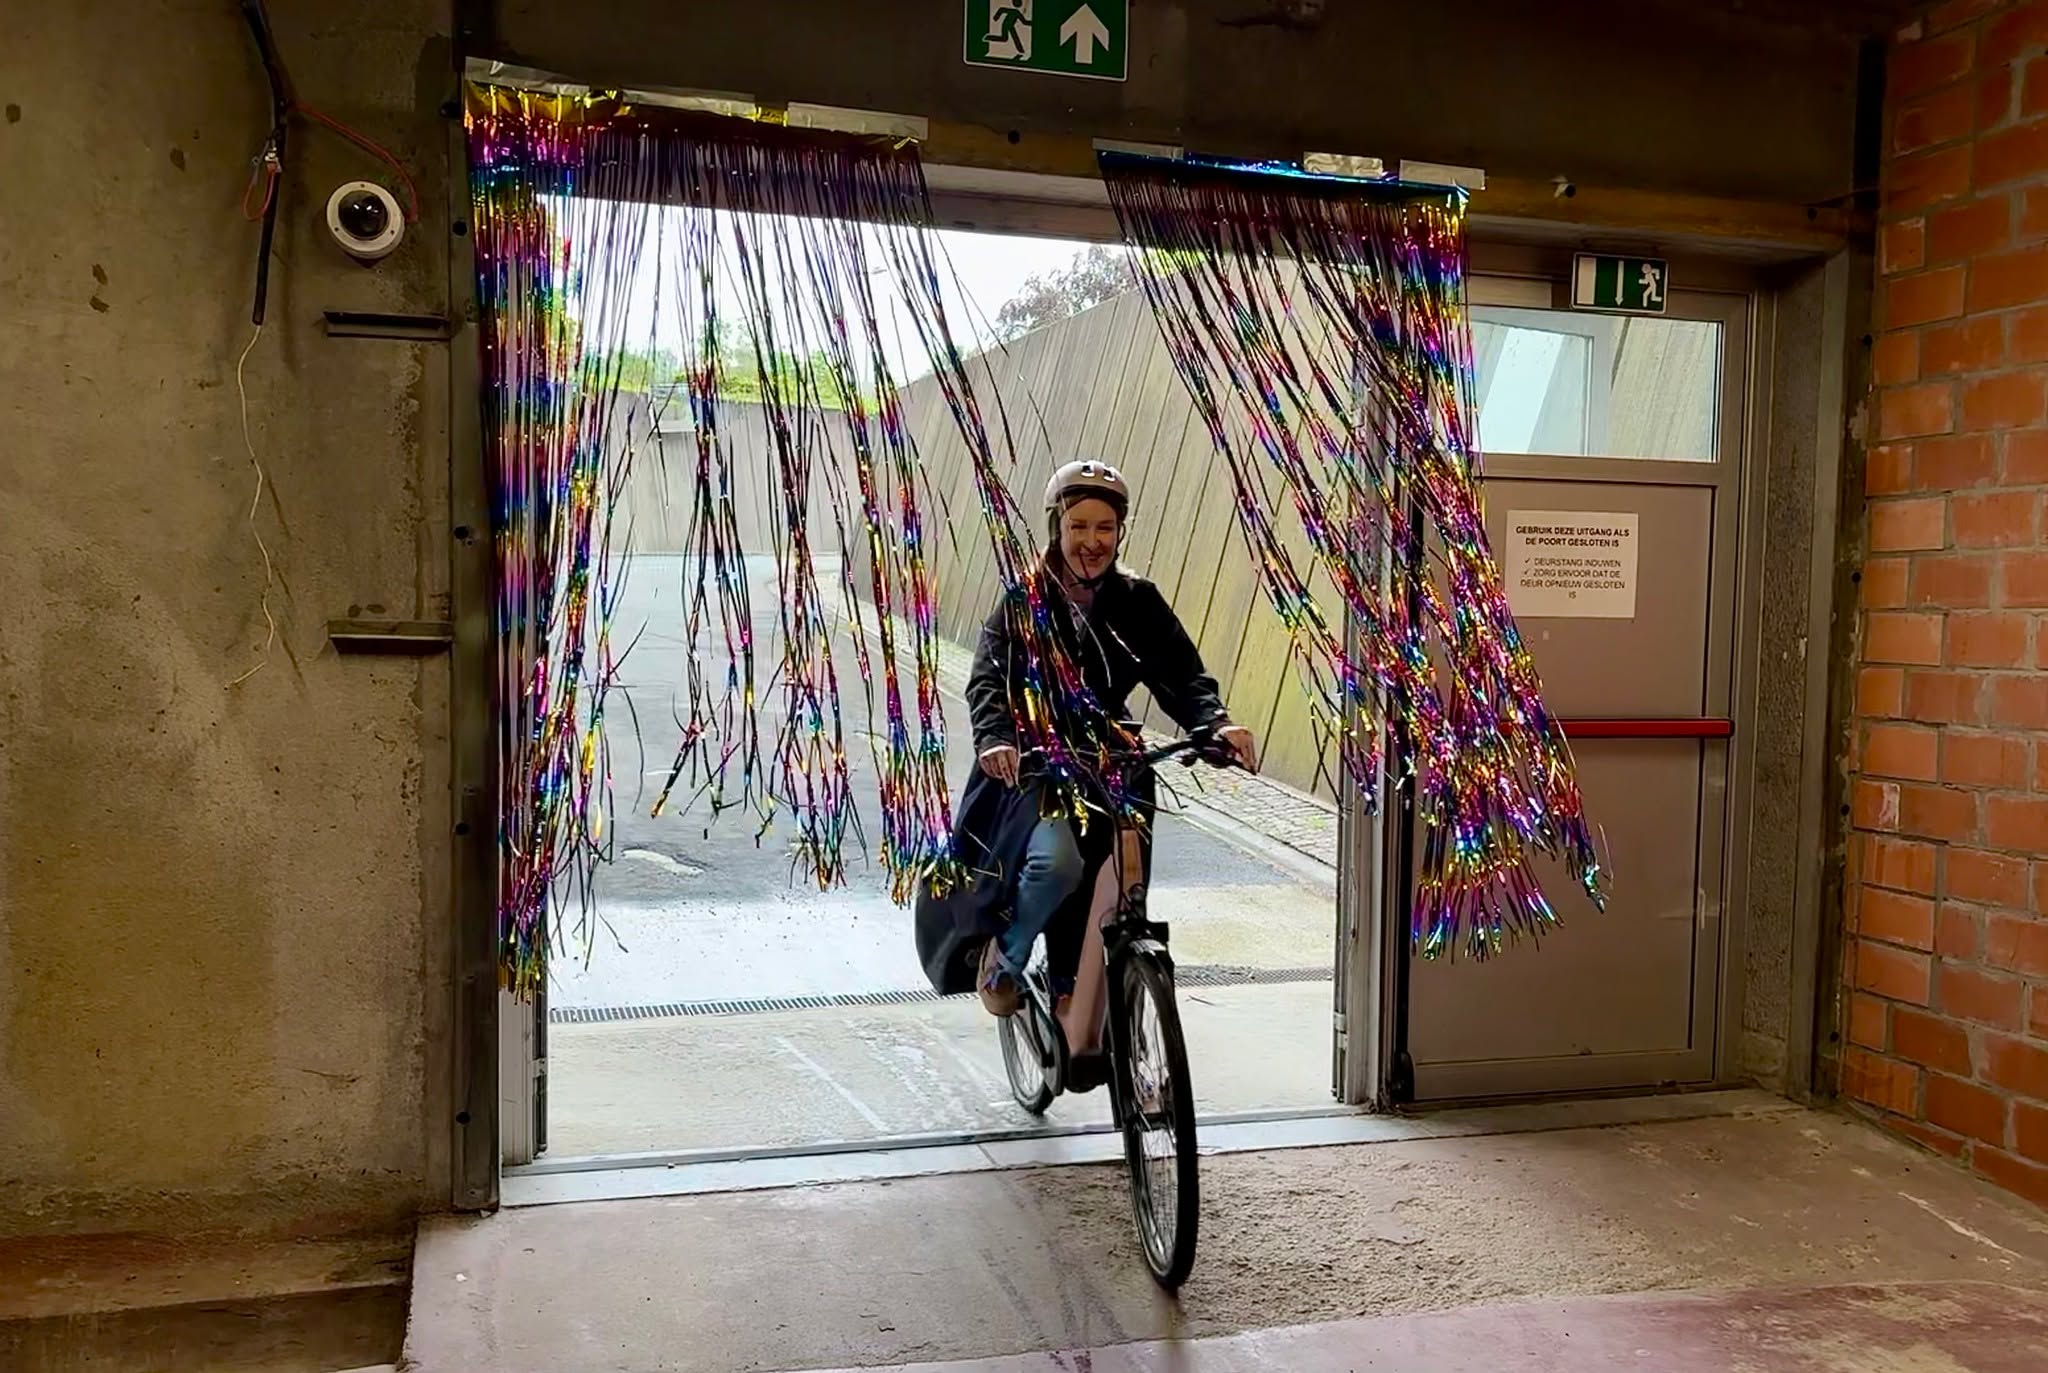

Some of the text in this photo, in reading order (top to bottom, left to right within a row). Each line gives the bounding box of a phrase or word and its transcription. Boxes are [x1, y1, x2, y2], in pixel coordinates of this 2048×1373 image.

[1516, 526, 1629, 537] GEBRUIK DEZE UITGANG ALS
[1526, 537, 1536, 545] DE
[1539, 537, 1566, 546] POORT
[1568, 538, 1610, 547] GESLOTEN
[1534, 558, 1583, 567] DEURSTANG
[1533, 569, 1620, 578] ZORG ERVOOR DAT DE
[1520, 579, 1625, 589] DEUR OPNIEUW GESLOTEN
[1569, 591, 1576, 599] IS
